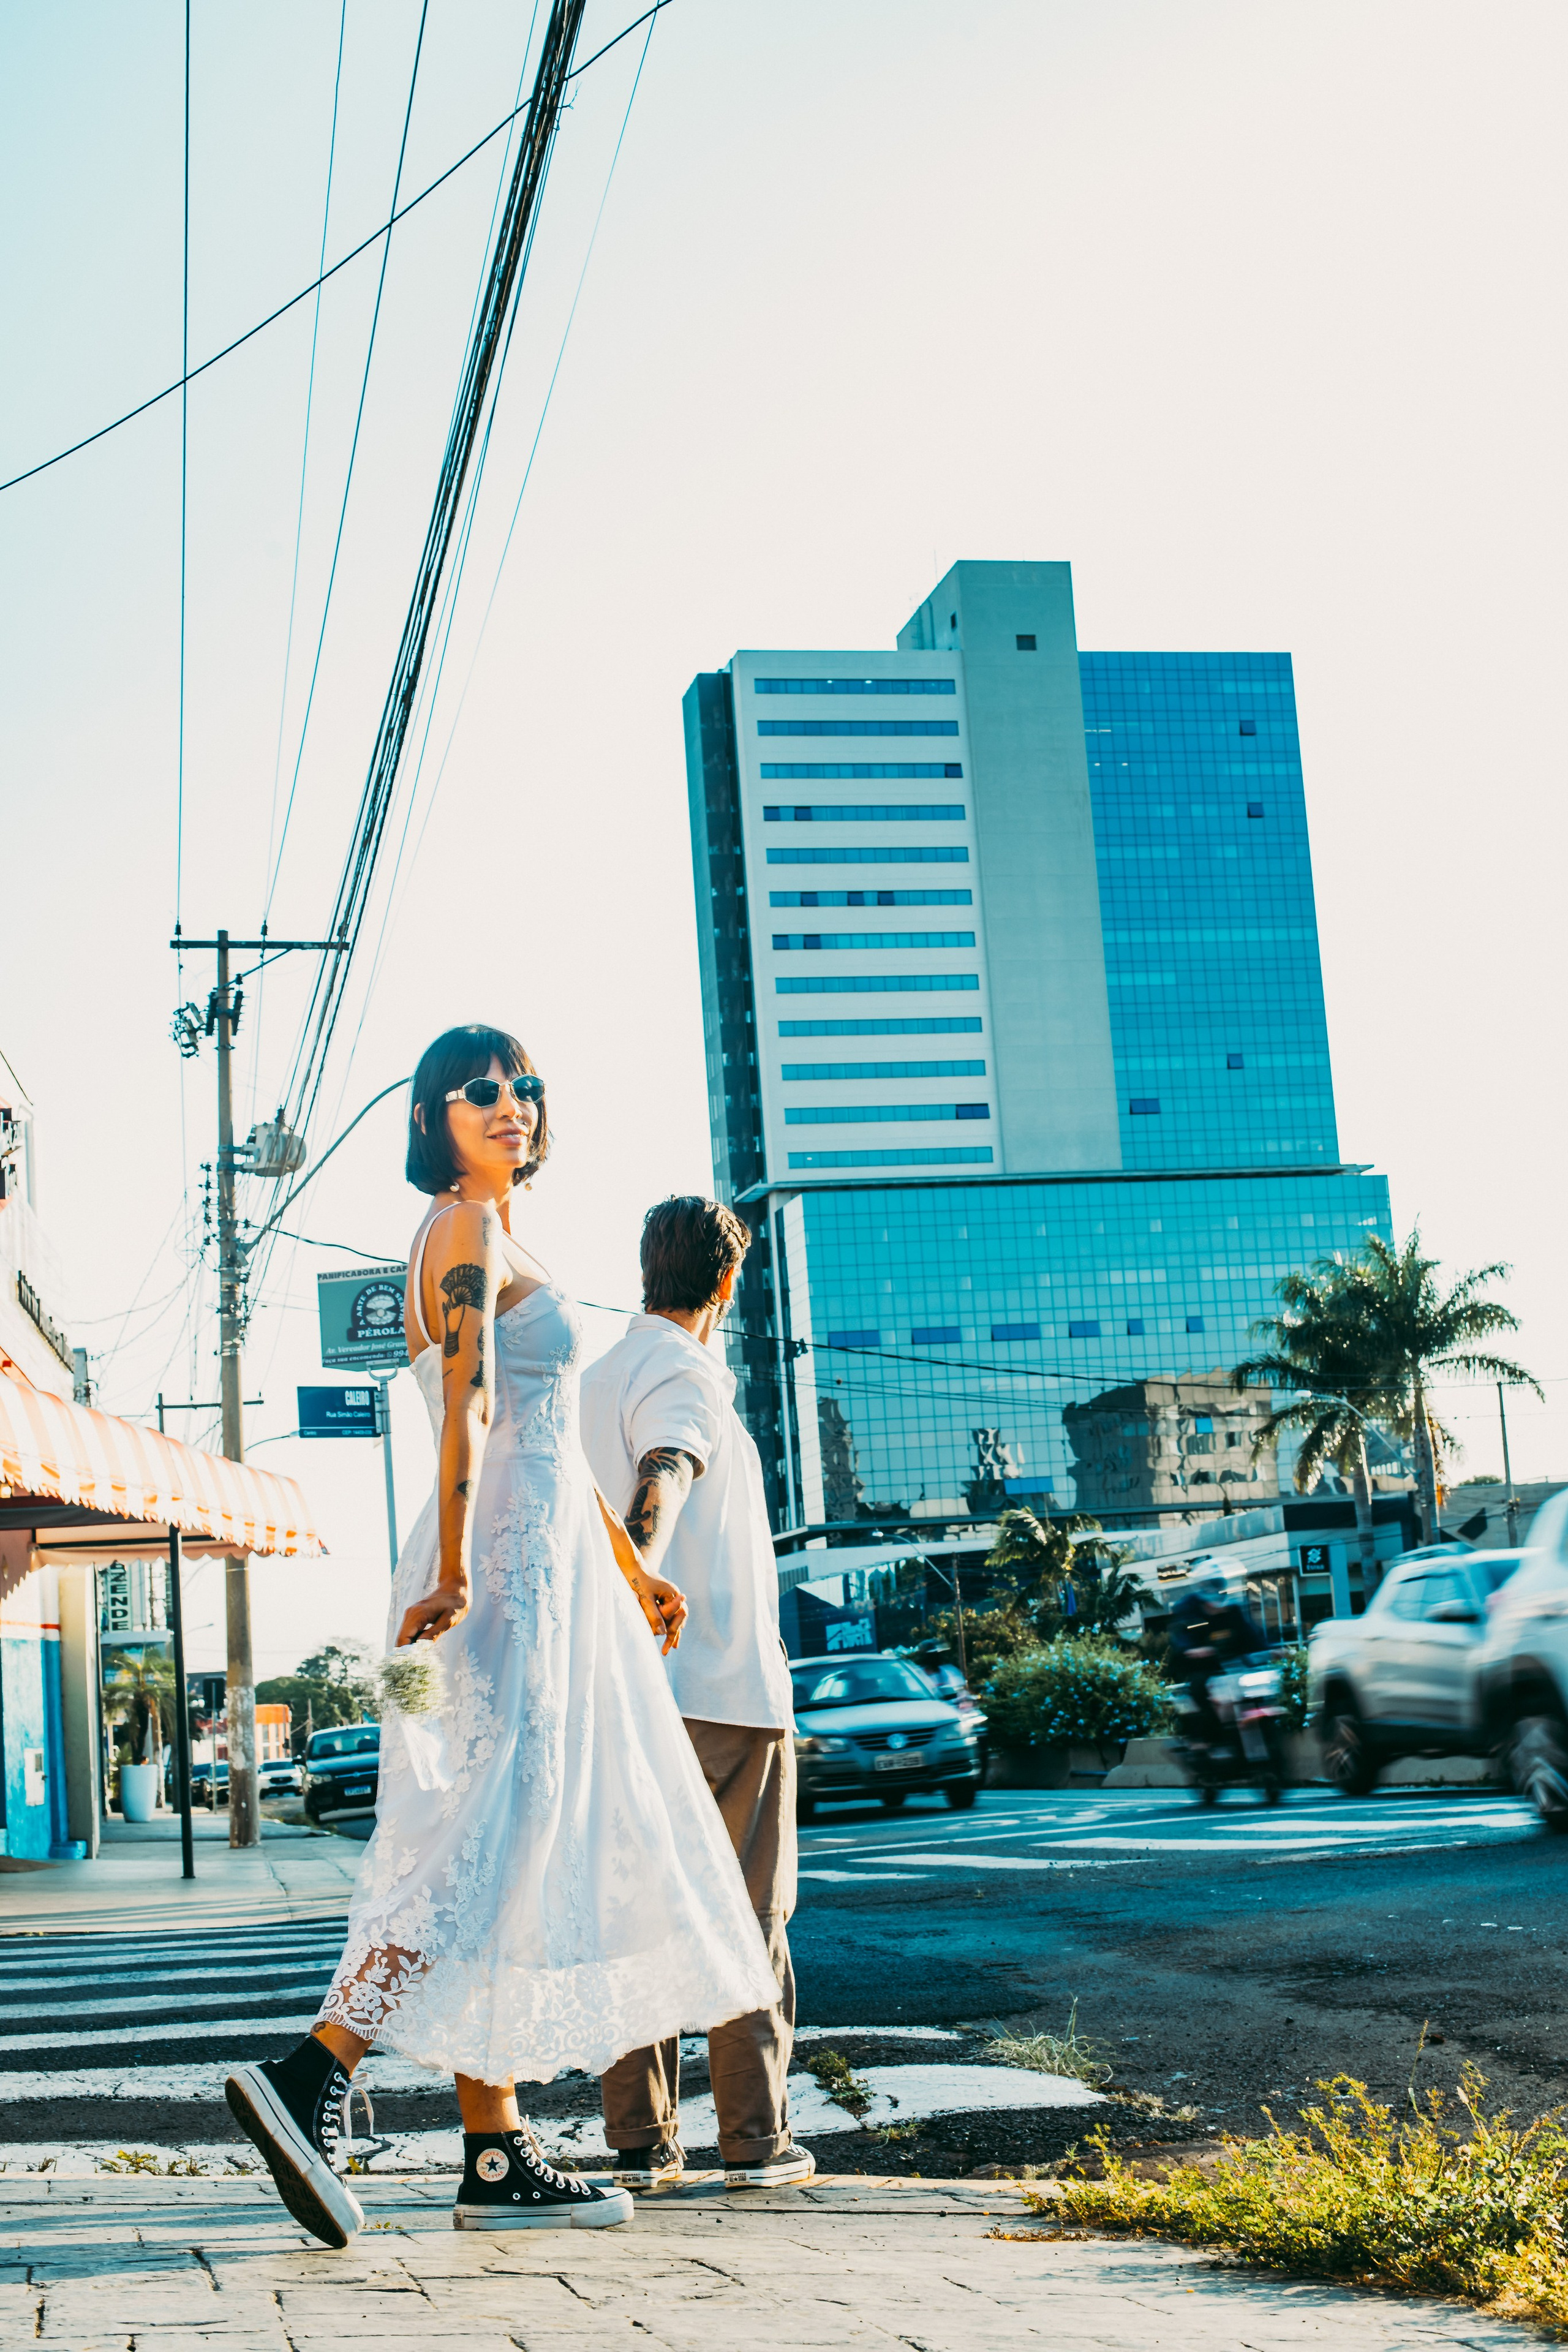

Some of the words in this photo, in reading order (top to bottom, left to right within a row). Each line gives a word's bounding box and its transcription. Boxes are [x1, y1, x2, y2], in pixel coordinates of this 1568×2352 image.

[317, 1268, 381, 1281] PANIFICADORA
[356, 1295, 366, 1317] ARTE
[366, 1286, 377, 1295] DE
[379, 1284, 395, 1294] BEM
[357, 1327, 406, 1338] PÉROLA
[337, 1344, 371, 1352] Vereador
[345, 1390, 370, 1406] CALEIRO
[480, 2151, 505, 2163] CONVERSE
[491, 2170, 503, 2179] STAR
